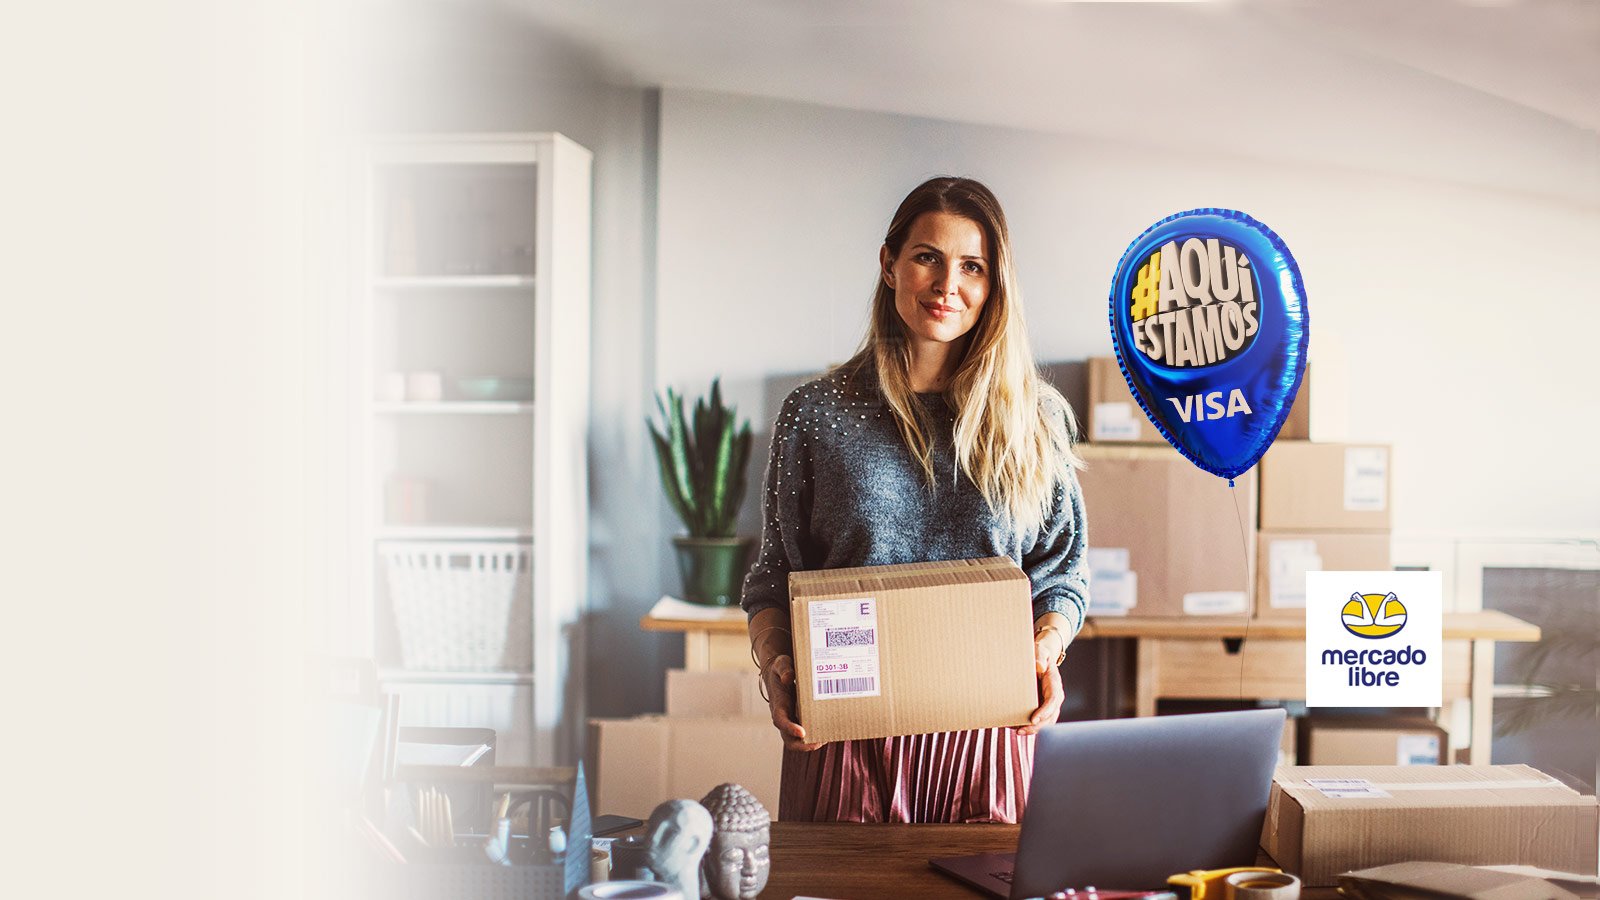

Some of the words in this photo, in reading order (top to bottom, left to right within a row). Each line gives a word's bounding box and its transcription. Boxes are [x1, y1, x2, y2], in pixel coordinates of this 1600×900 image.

[1132, 301, 1259, 367] ESTAMOS
[1166, 388, 1252, 423] VISA
[860, 602, 870, 615] E
